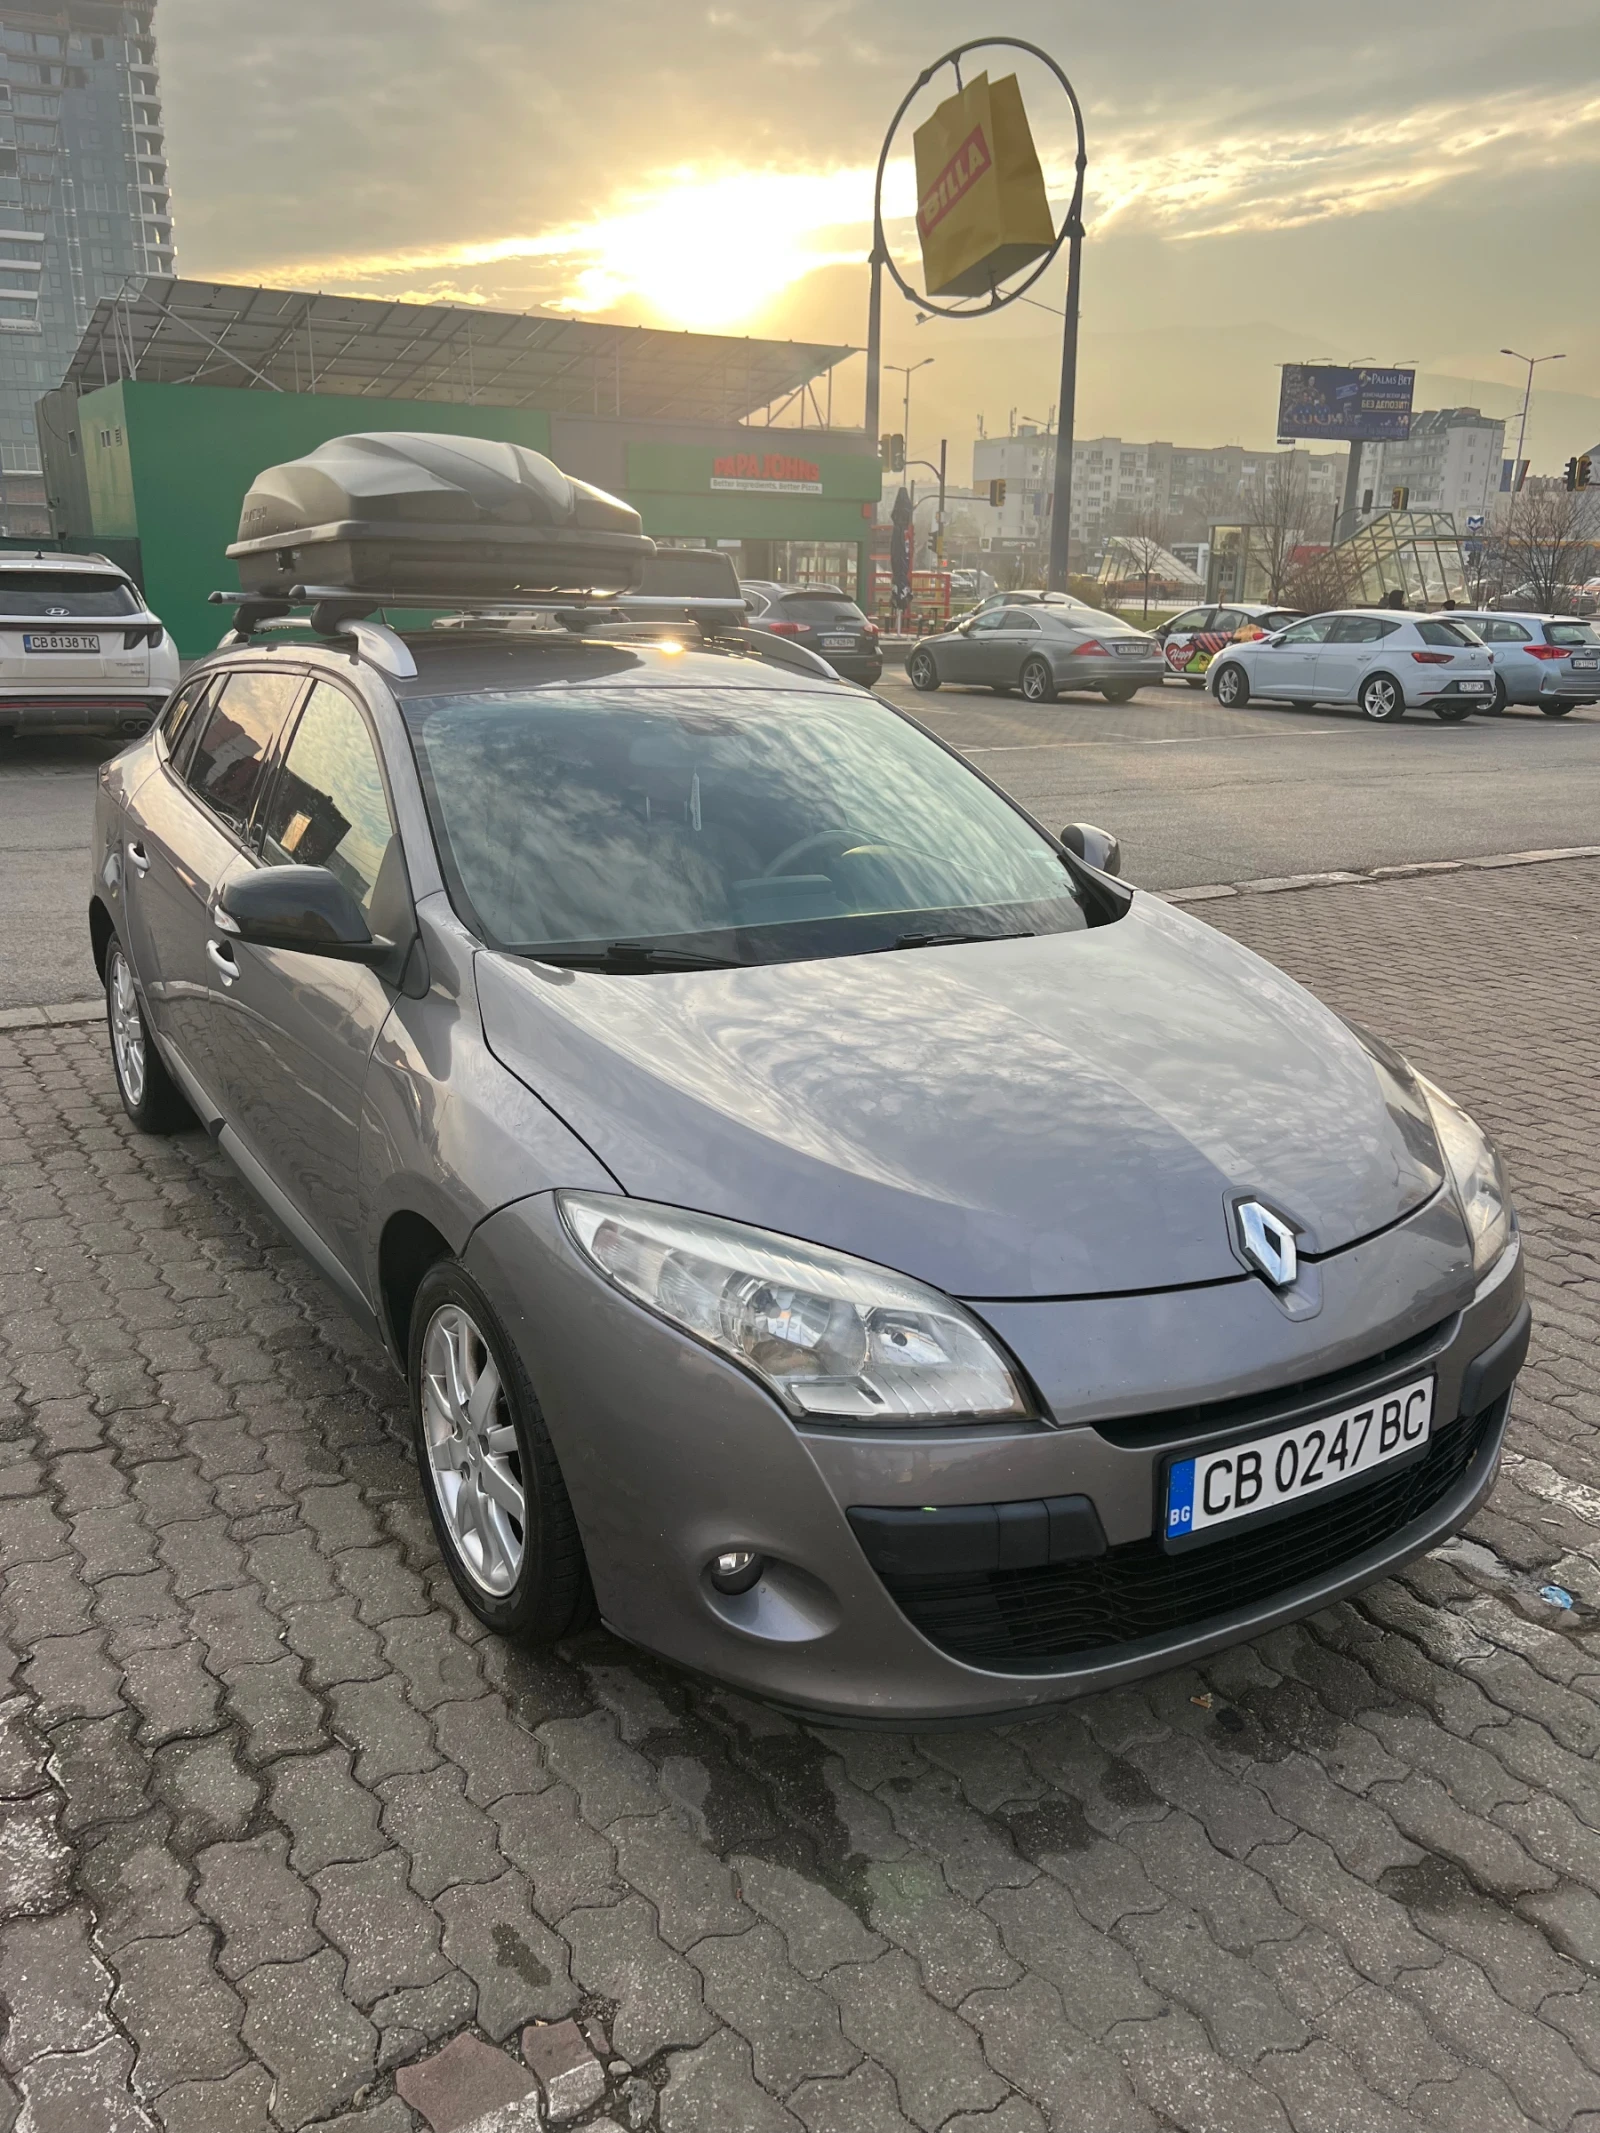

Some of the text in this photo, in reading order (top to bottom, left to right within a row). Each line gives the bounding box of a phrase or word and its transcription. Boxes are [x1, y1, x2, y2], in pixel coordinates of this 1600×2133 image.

[922, 141, 985, 226] BILLA
[1371, 373, 1412, 386] PALMS BET
[1361, 400, 1375, 408] БЕЗ
[714, 453, 760, 478] PAPA
[779, 482, 800, 490] Better
[32, 637, 97, 649] CB 8138 TK
[1169, 648, 1194, 661] Happy
[1203, 1389, 1426, 1516] CB 0247 BC
[1169, 1504, 1191, 1527] BG
